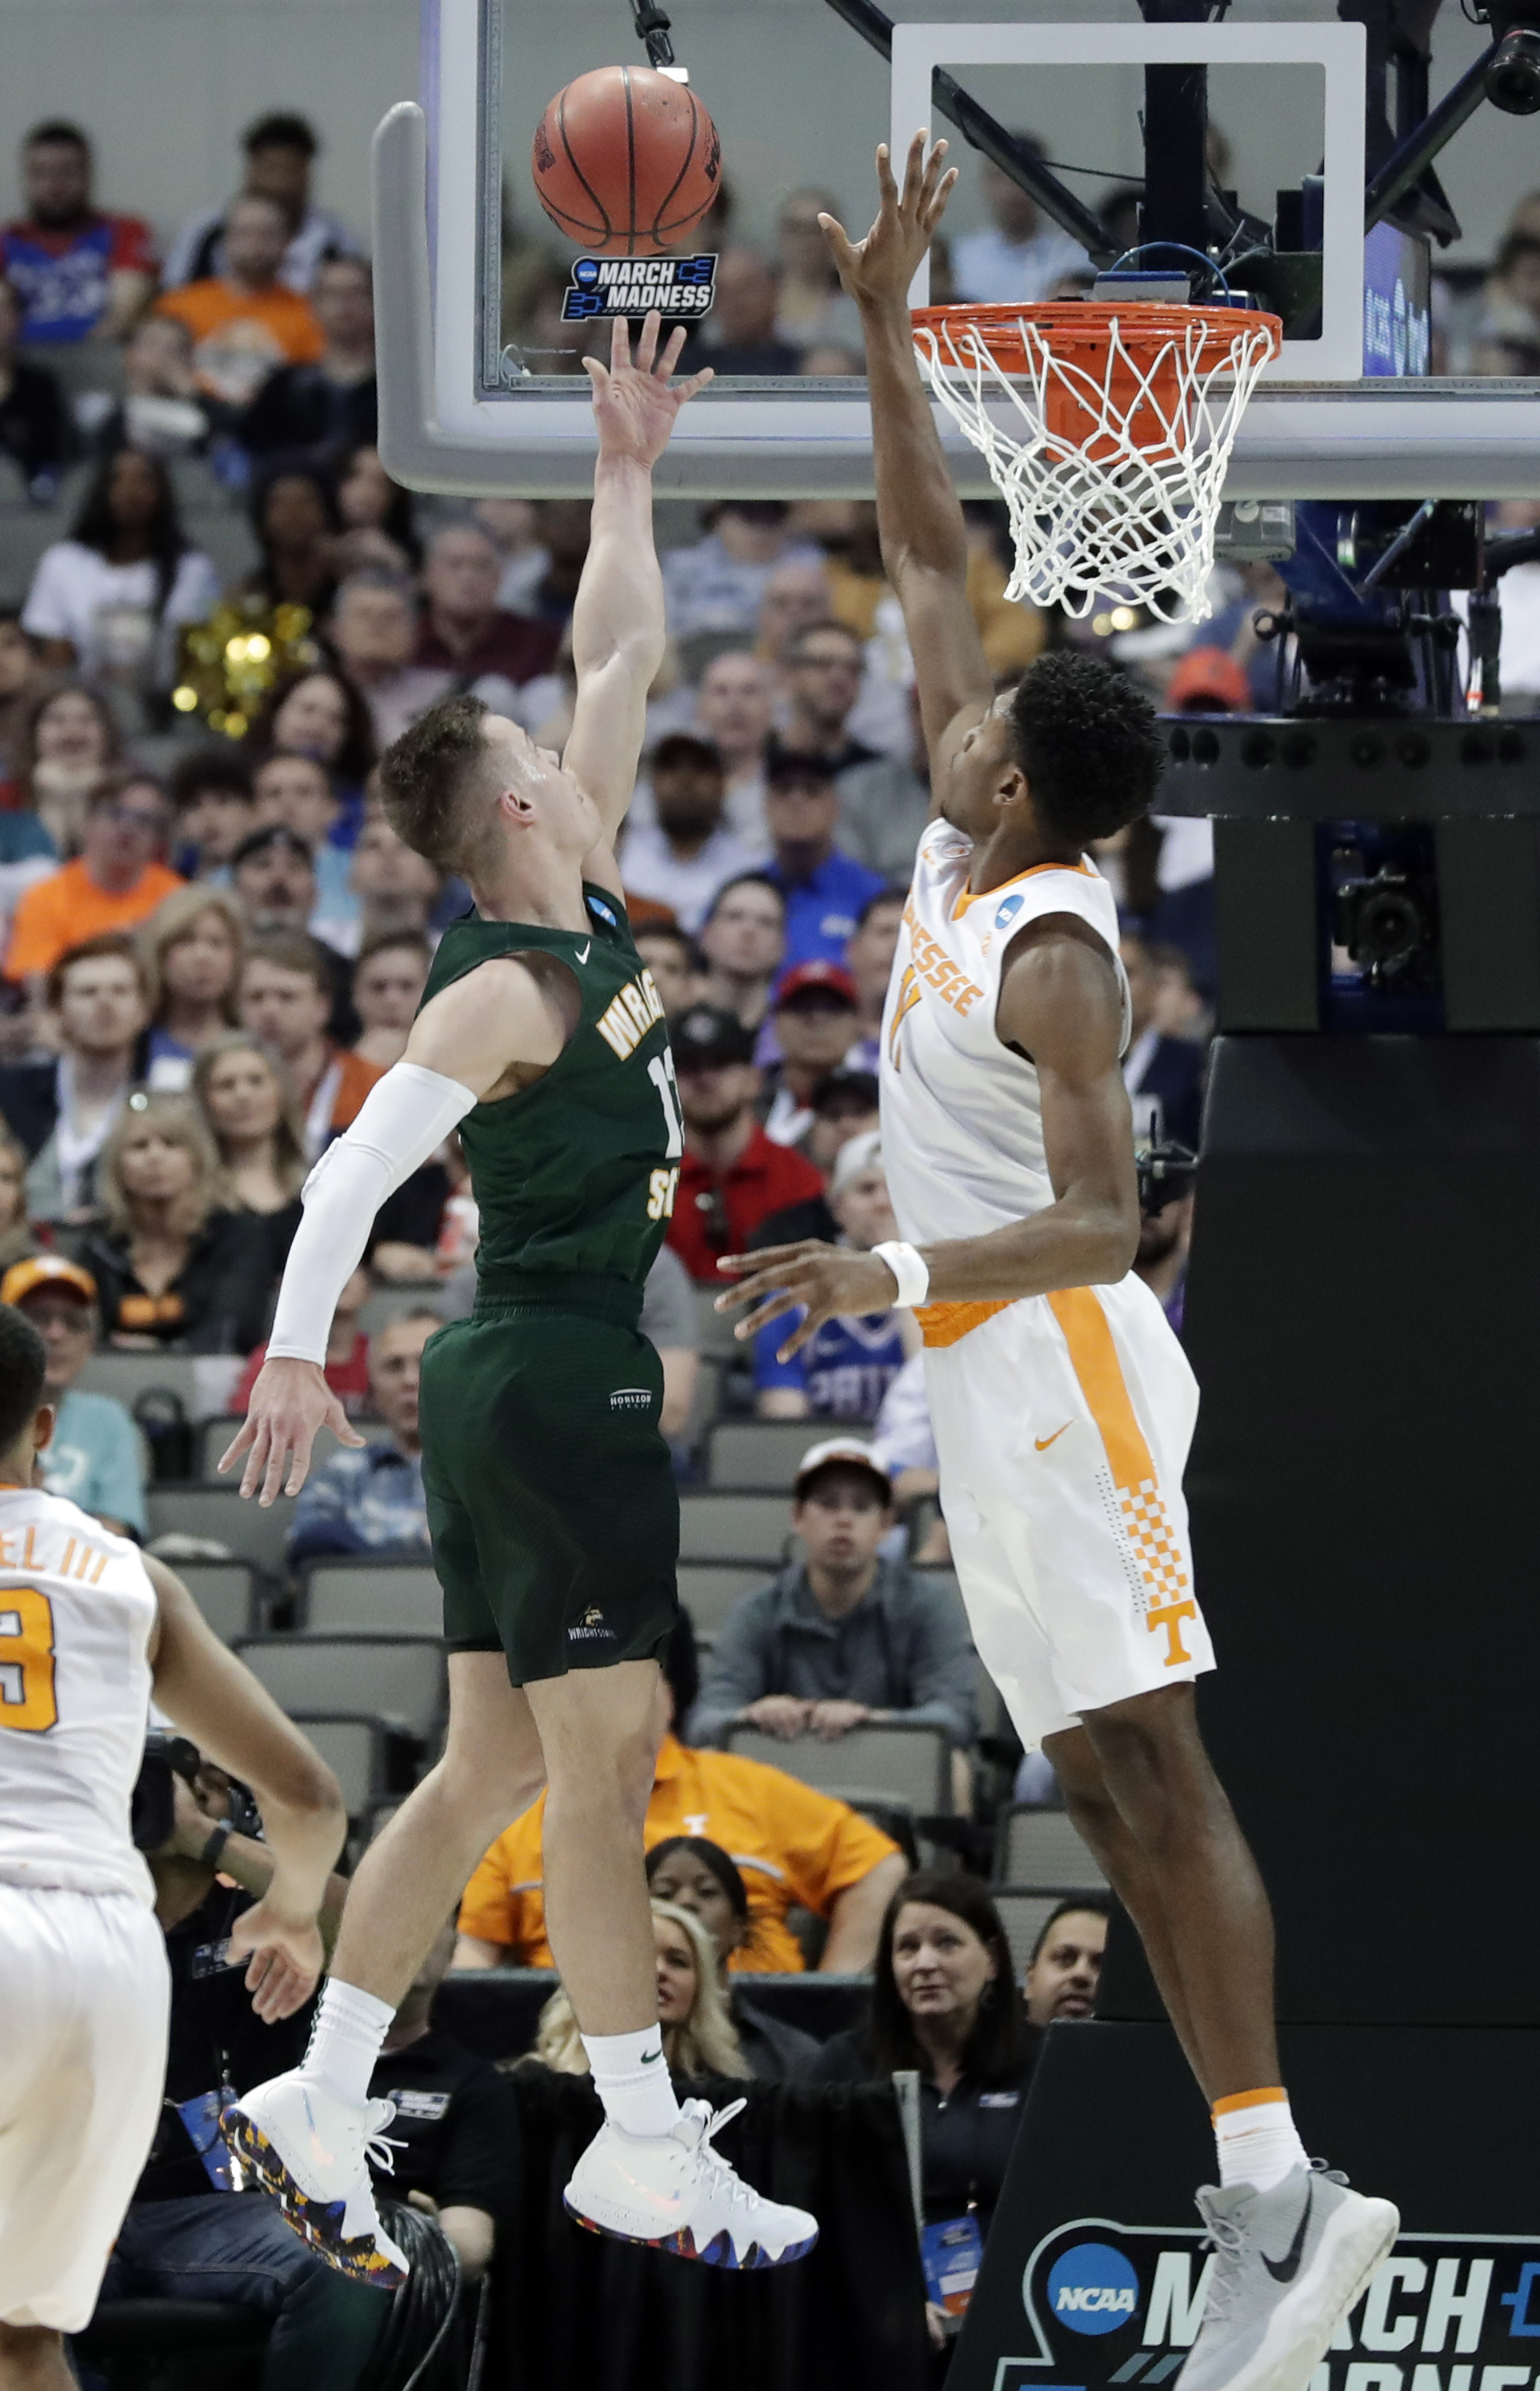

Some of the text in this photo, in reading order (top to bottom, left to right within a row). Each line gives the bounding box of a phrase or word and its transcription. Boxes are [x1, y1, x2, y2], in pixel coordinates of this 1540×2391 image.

[598, 262, 675, 285] MARCH
[606, 285, 711, 308] MADNESS
[595, 968, 666, 1062] WRIG
[610, 1394, 652, 1406] HORIZON
[59, 1537, 109, 1585] III
[1146, 1597, 1197, 1668] T
[1056, 2286, 1135, 2313] NCAA
[1142, 2251, 1495, 2354] MCH
